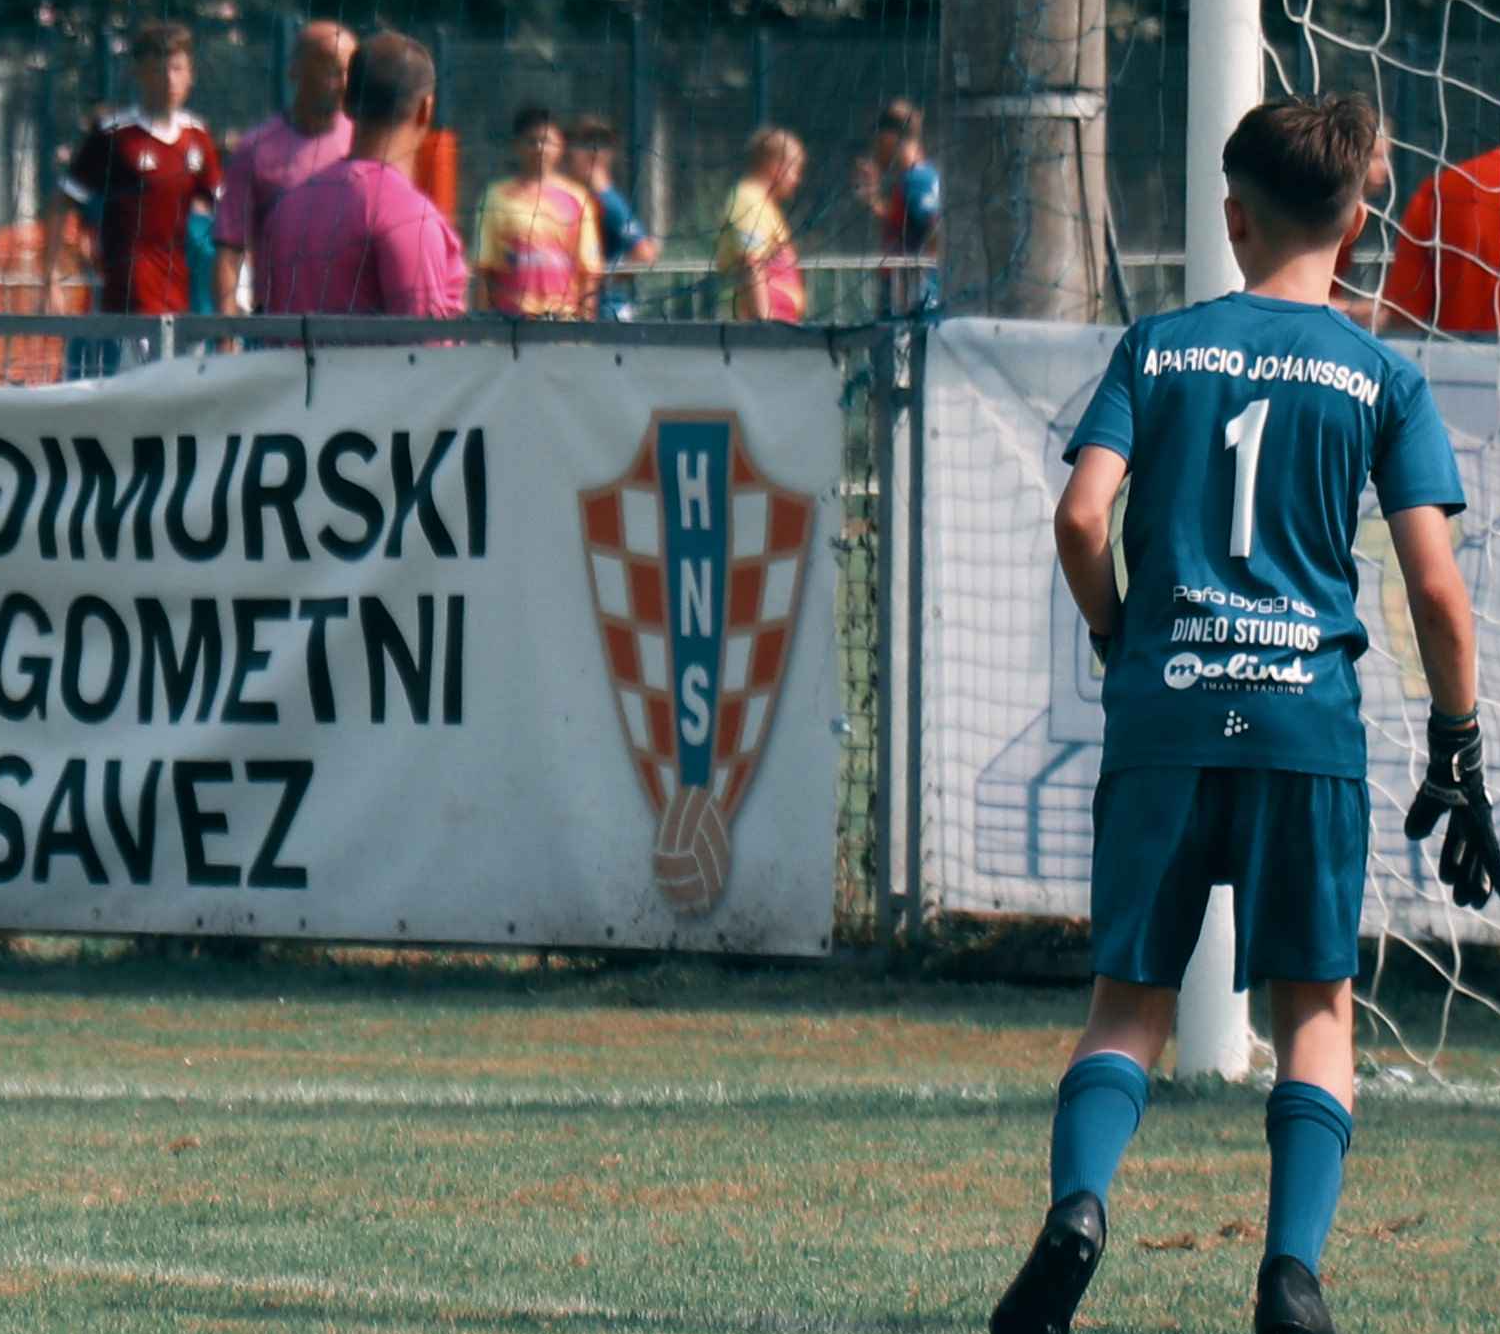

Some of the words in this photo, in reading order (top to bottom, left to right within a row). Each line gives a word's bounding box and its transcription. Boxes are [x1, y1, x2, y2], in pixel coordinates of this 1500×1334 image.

[1143, 347, 1245, 376] APARICIO
[1247, 354, 1380, 406] JOHANSSON
[1225, 398, 1270, 557] 1
[1170, 617, 1228, 643] DINEO
[1234, 618, 1321, 651] STUDIOS
